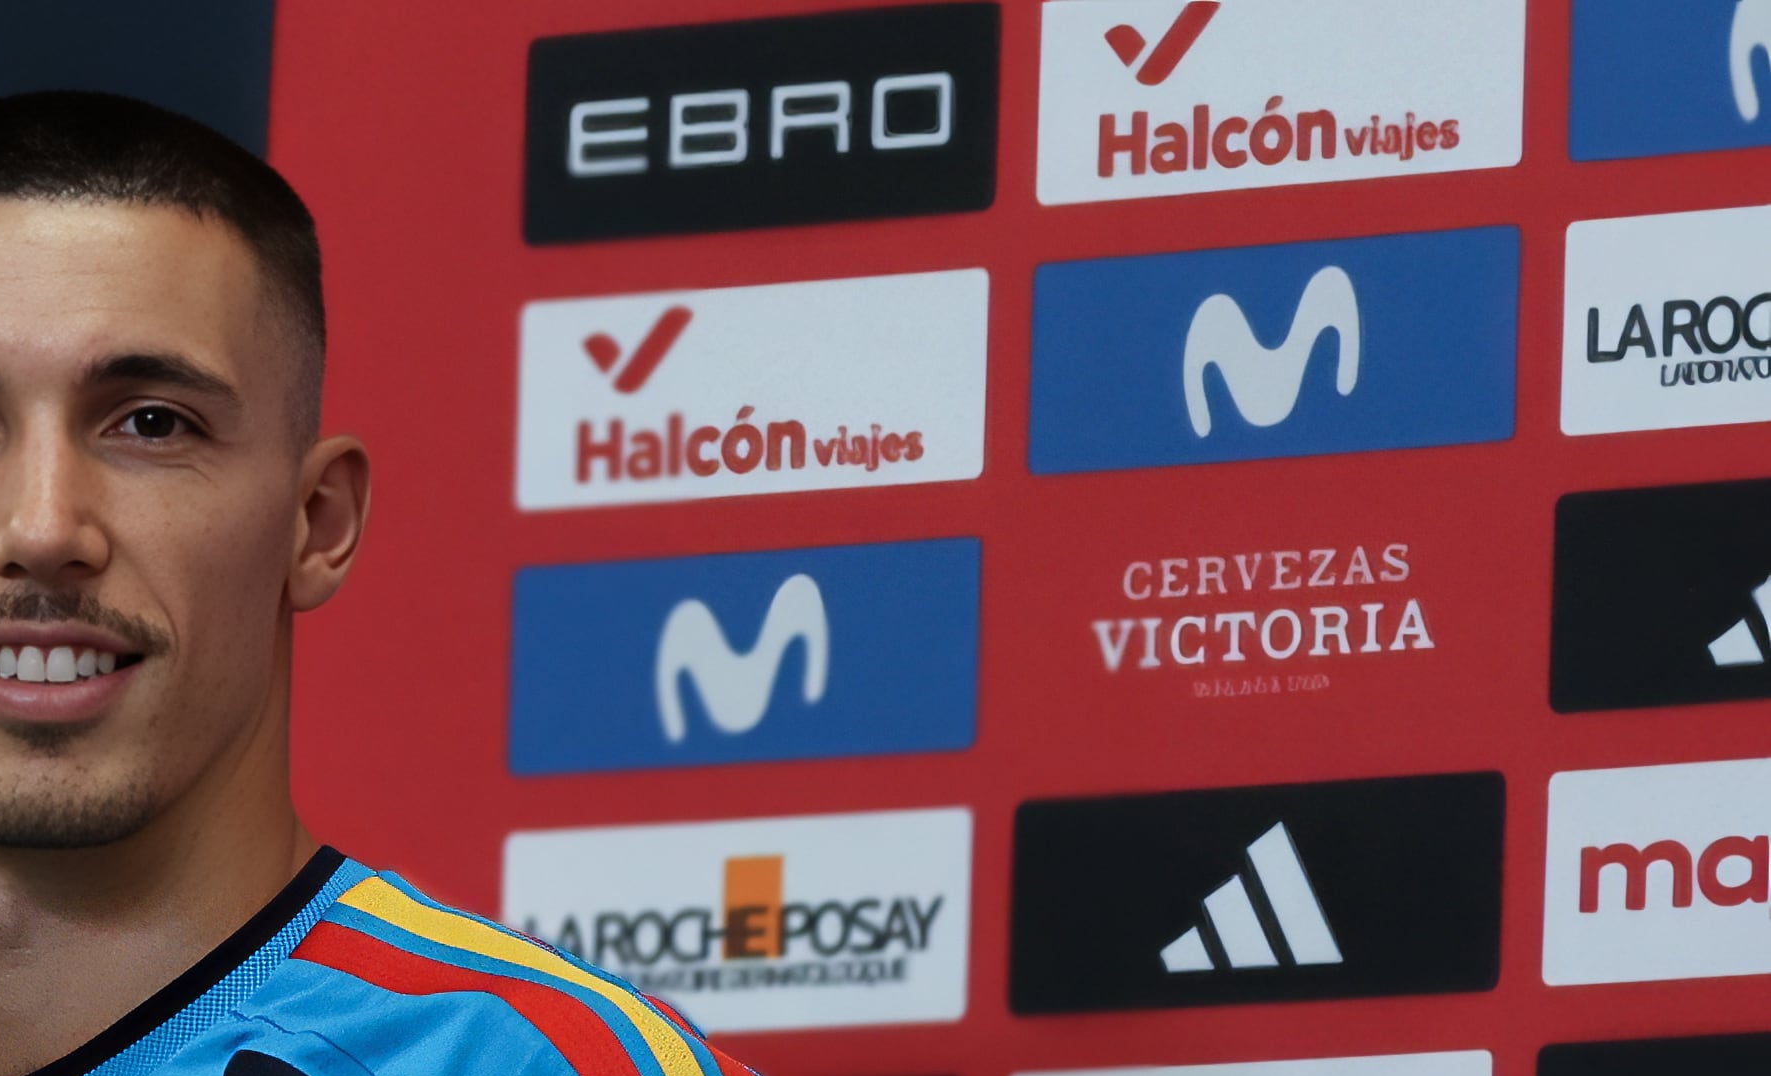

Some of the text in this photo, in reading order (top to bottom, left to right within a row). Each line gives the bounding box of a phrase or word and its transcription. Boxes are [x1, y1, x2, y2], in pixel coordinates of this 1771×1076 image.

[567, 71, 953, 177] EBRO
[1098, 95, 1460, 178] Halcón viajes
[574, 405, 807, 485] Halcón
[1123, 543, 1410, 600] CERVEZAS
[1092, 598, 1435, 674] VICTORIA
